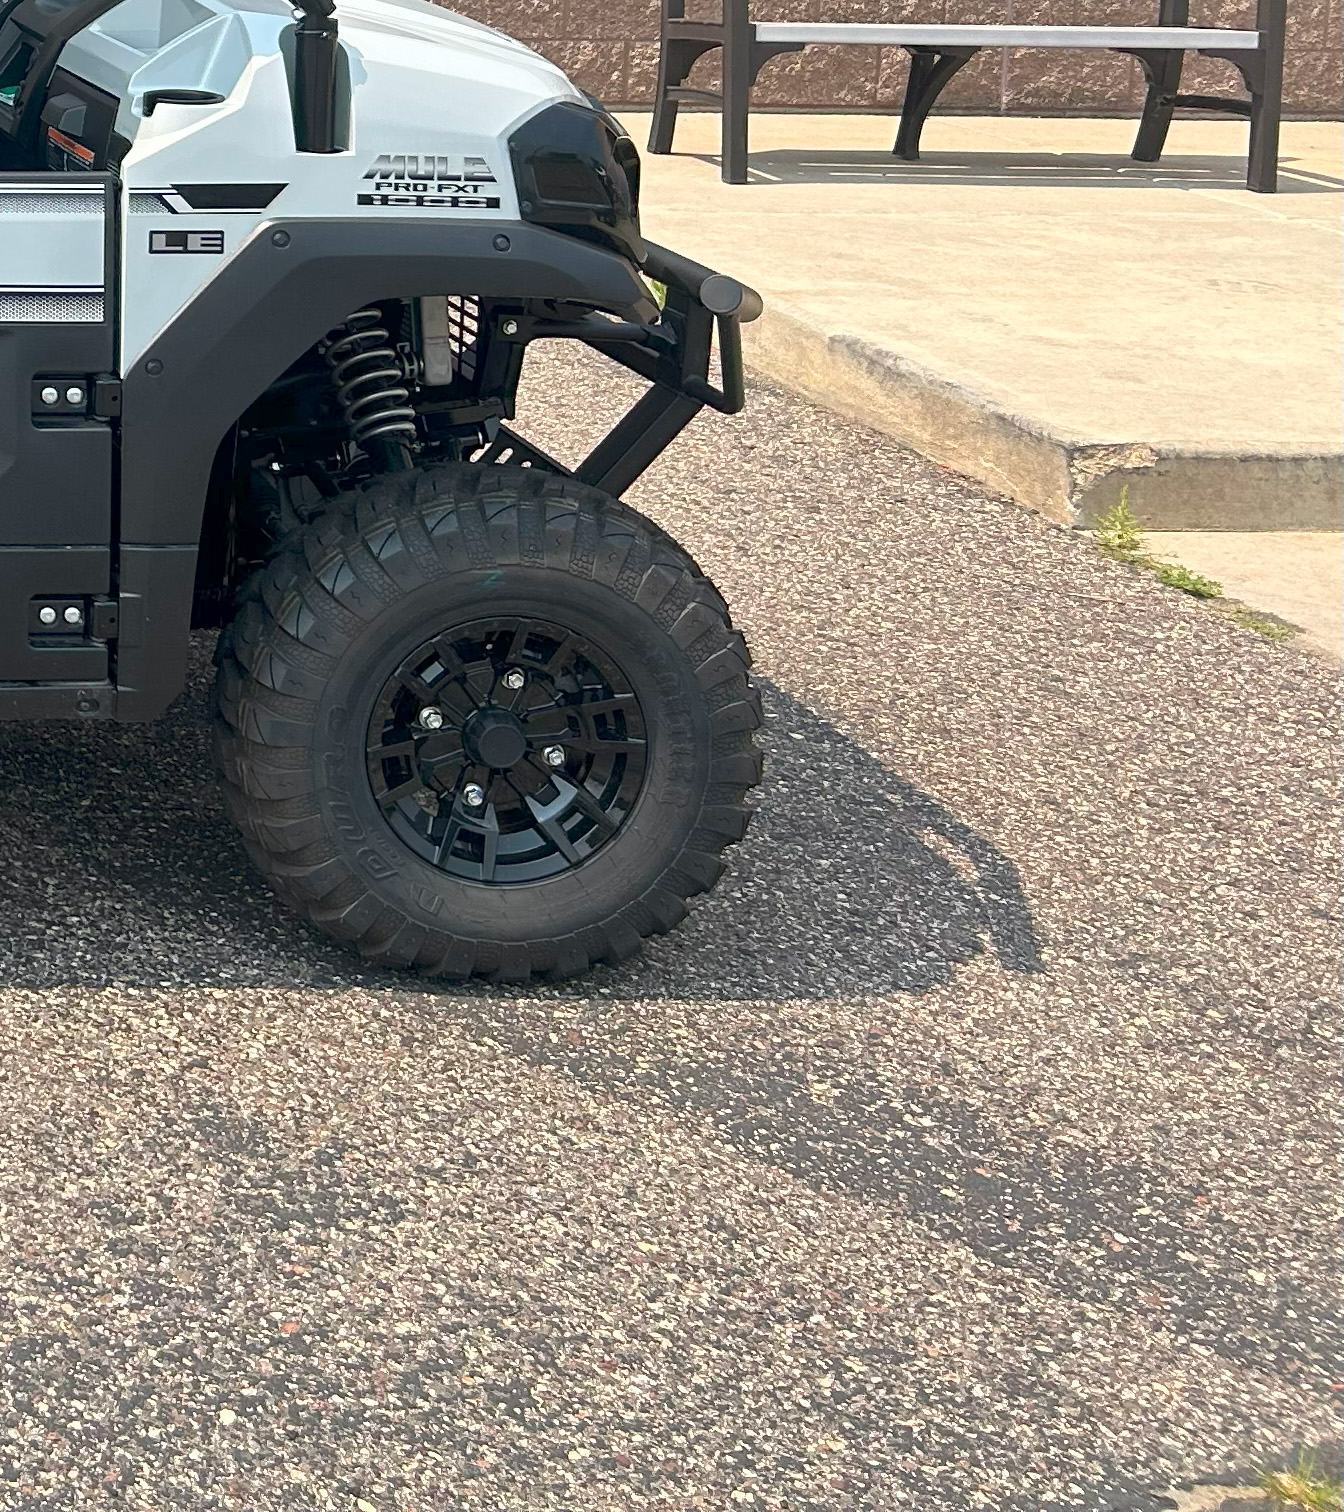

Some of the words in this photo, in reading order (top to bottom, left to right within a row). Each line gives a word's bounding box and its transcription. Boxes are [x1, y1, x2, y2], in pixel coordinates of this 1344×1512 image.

[362, 154, 498, 183] MULE
[374, 181, 485, 194] PRO-FXT
[369, 194, 489, 208] 1000
[152, 233, 222, 251] LE
